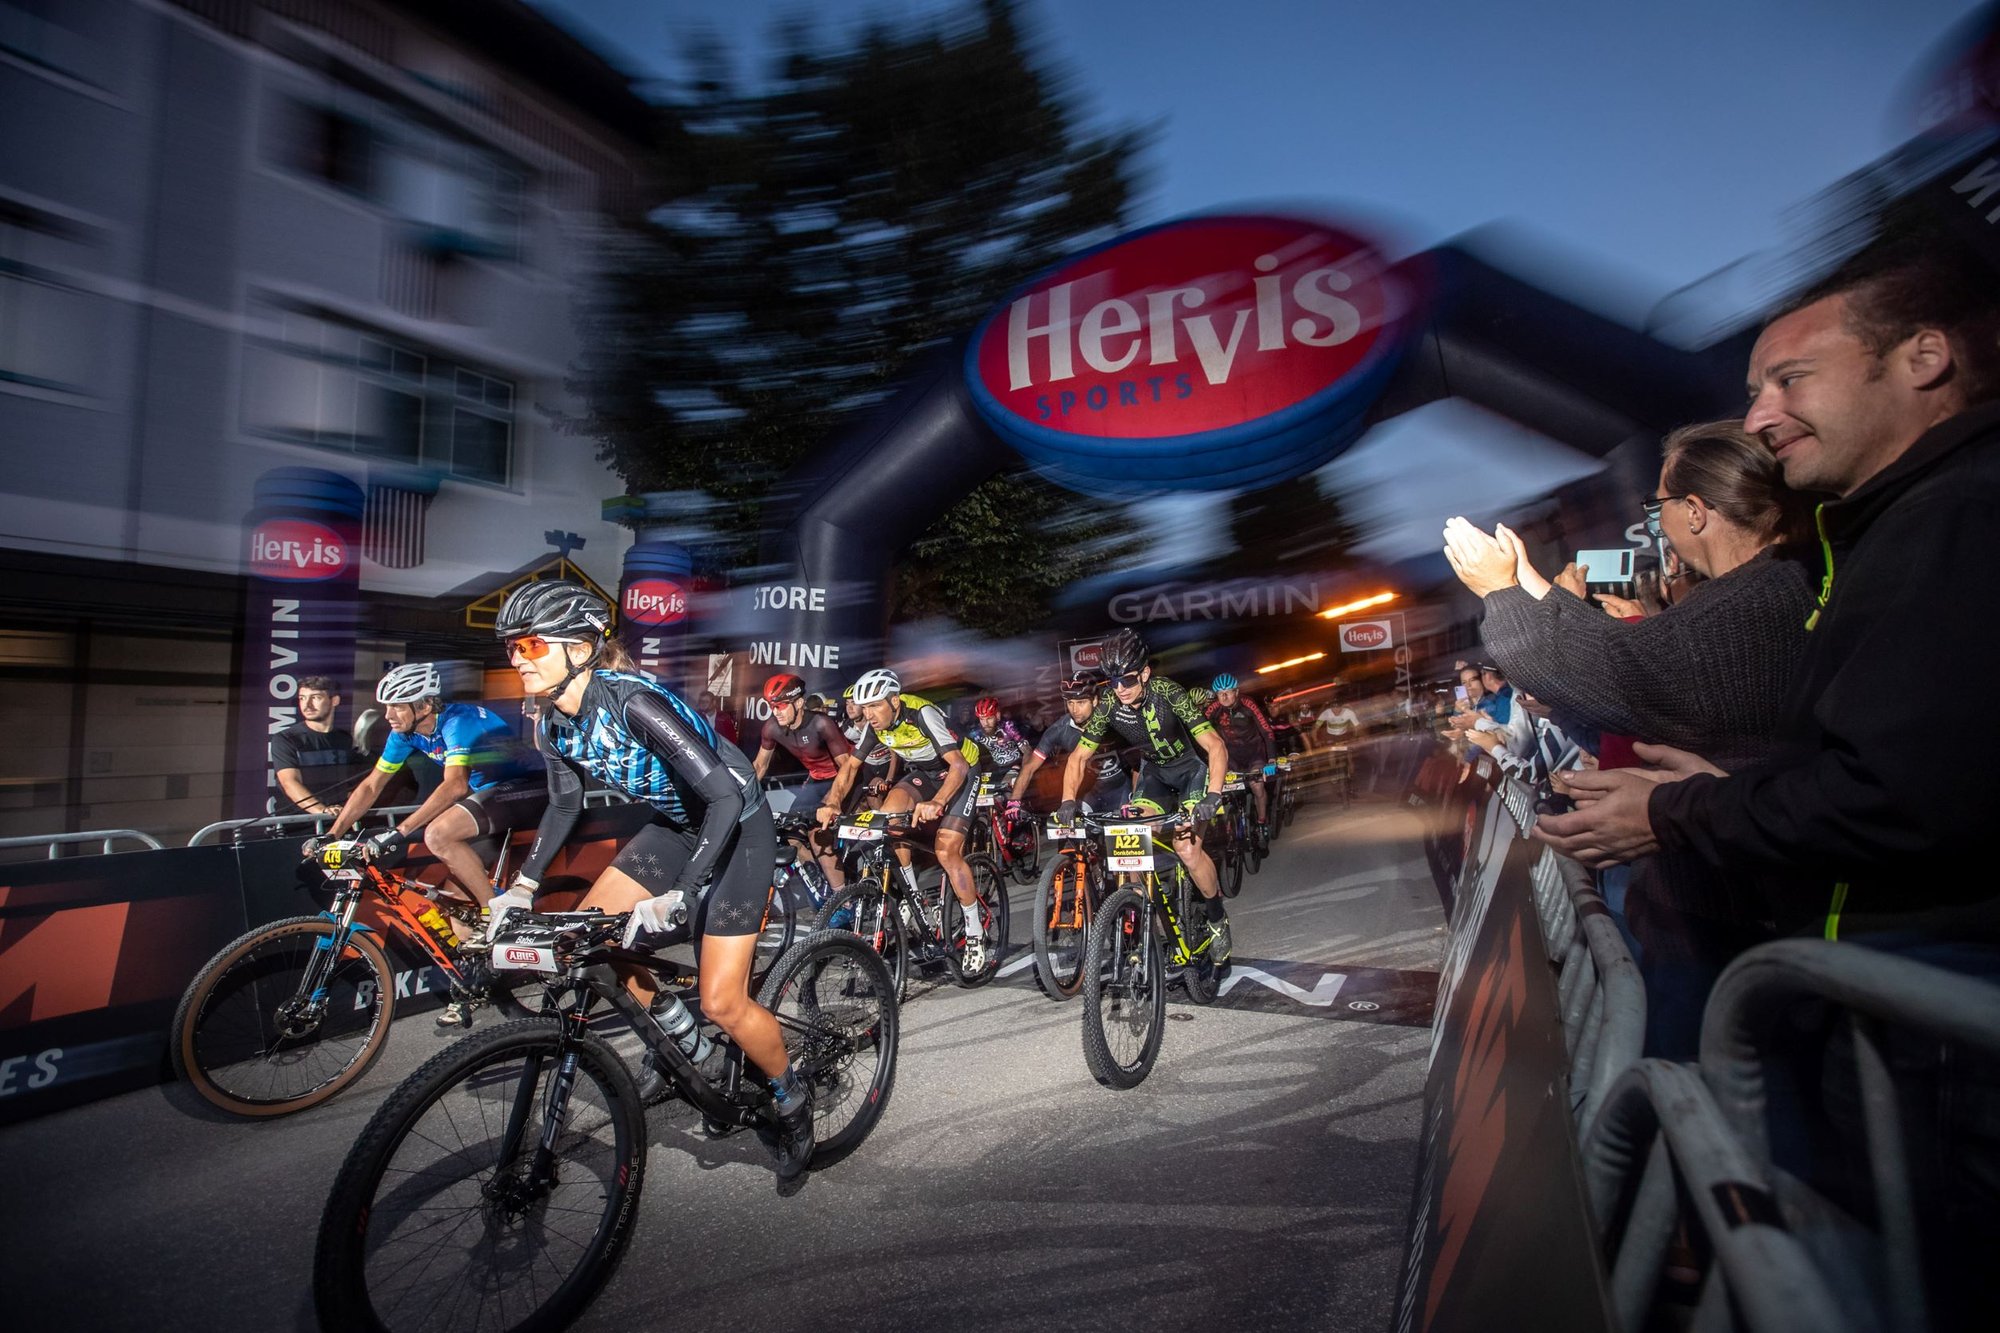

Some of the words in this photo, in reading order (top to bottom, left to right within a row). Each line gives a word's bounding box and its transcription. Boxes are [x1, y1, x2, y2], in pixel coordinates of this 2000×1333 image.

[1008, 254, 1361, 393] Hervis
[1037, 374, 1194, 420] SPORTS
[251, 533, 341, 568] Hervis
[626, 589, 685, 616] Hervis
[754, 586, 826, 612] STORE
[1109, 582, 1319, 623] GARMIN
[1348, 628, 1384, 642] Hervis
[749, 641, 840, 669] ONLINE
[1115, 835, 1140, 849] A22
[324, 849, 342, 864] A79
[515, 936, 537, 945] Babsi
[509, 951, 536, 961] ABUS
[354, 965, 433, 1010] BKE
